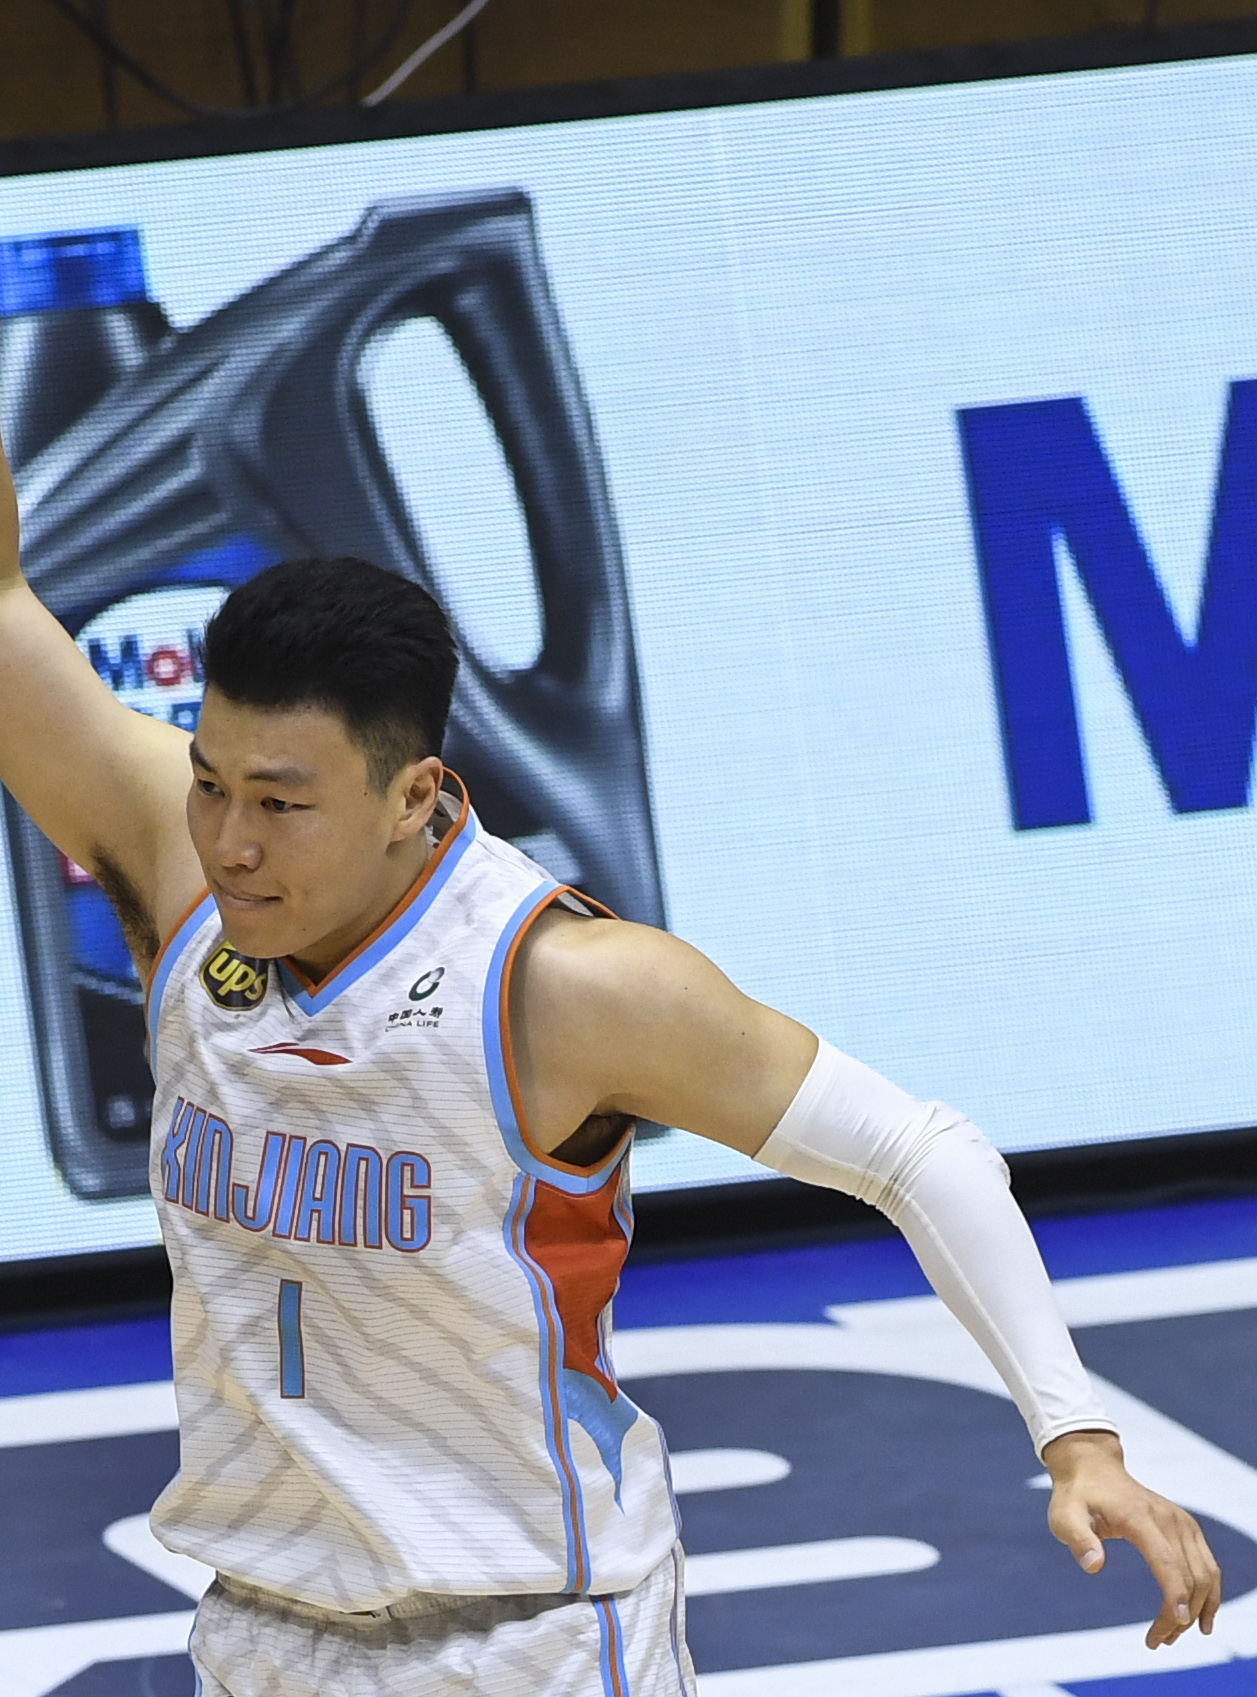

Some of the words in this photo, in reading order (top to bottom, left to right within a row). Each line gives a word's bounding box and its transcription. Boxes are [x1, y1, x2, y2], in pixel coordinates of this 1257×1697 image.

[416, 1020, 439, 1028] LIFE
[161, 1096, 431, 1253] XINJIANG
[278, 1279, 305, 1399] 1
